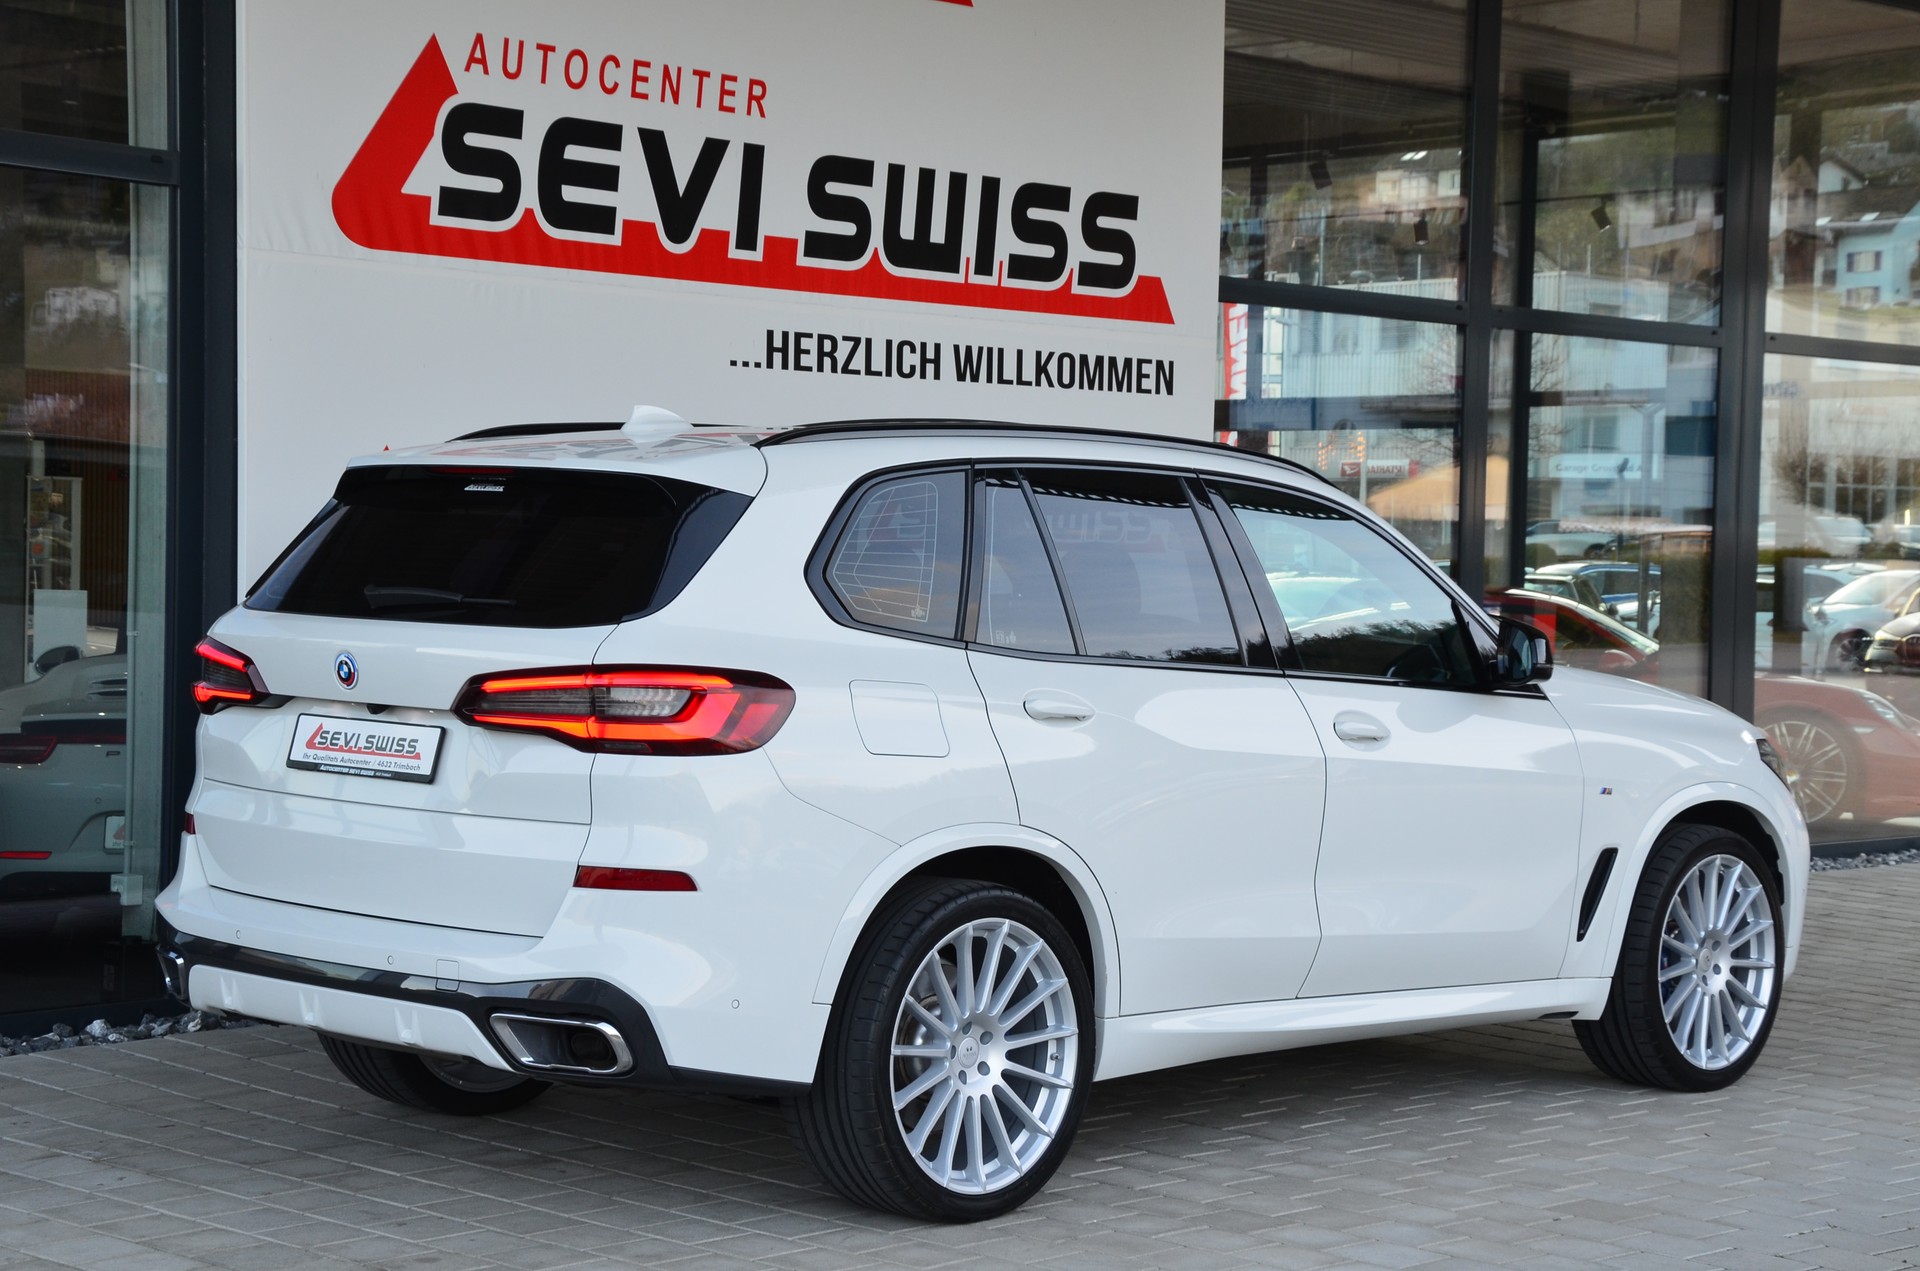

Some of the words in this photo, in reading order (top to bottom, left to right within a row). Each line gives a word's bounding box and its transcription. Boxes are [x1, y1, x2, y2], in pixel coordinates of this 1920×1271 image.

[464, 33, 767, 118] AUTOCENTER
[436, 102, 765, 252] SEVI
[803, 154, 1139, 291] SWISS
[730, 329, 941, 380] ...HERZLICH
[953, 344, 1175, 396] WILLKOMMEN
[303, 753, 311, 761] Ihr
[340, 757, 372, 766] Autocenter
[377, 760, 393, 768] 4632
[393, 761, 421, 772] Trimbach
[318, 731, 361, 749] SEVI
[363, 735, 419, 755] SWISS
